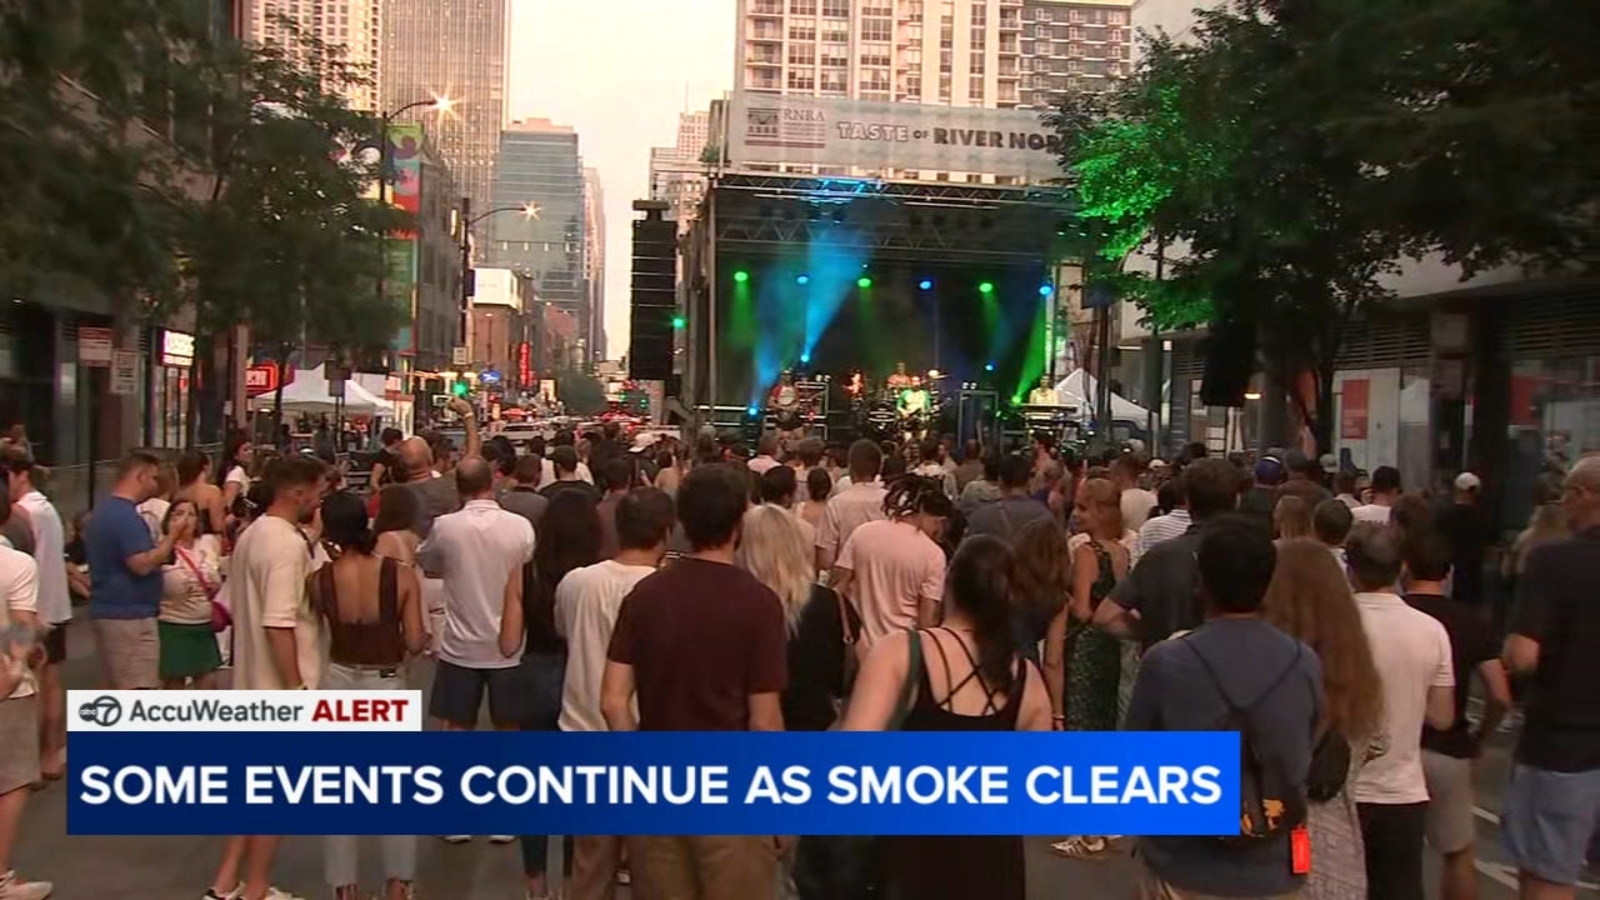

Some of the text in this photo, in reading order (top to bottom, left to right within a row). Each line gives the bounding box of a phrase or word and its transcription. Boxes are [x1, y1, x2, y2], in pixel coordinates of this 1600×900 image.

[783, 108, 826, 122] RNRA
[837, 121, 909, 142] TASTE
[913, 129, 929, 140] OF
[933, 127, 1004, 149] RIVER
